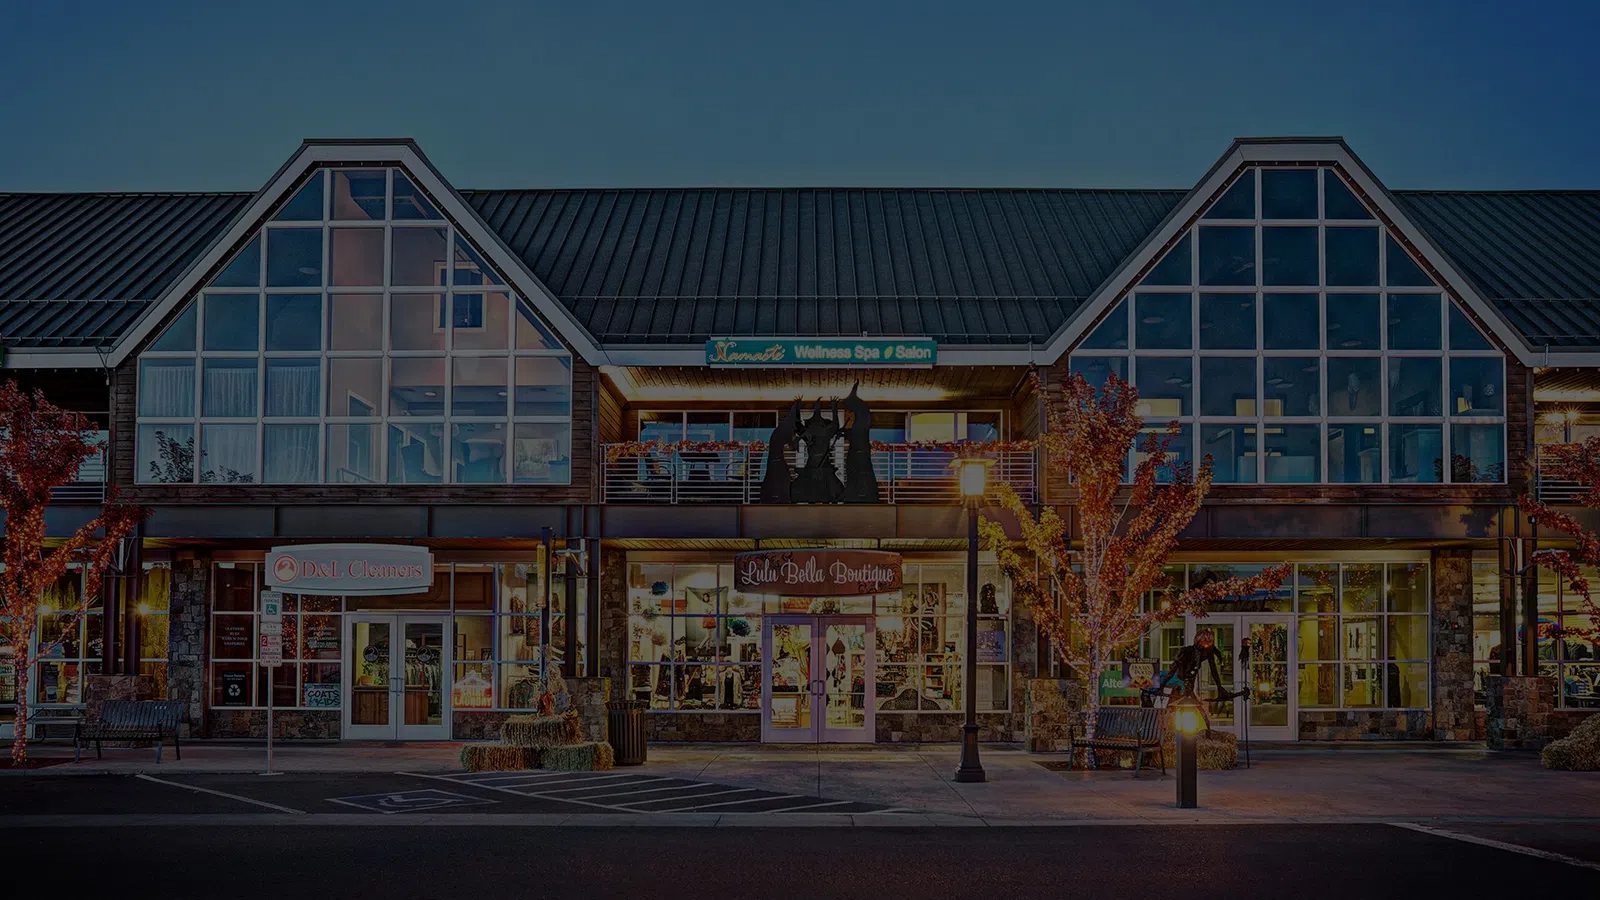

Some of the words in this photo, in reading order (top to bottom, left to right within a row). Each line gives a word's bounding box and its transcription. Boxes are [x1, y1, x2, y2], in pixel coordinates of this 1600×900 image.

[794, 345, 851, 359] Wellness
[854, 345, 880, 361] Spa
[895, 345, 931, 359] Salon
[302, 559, 344, 579] D&L
[348, 559, 424, 579] Cleaners
[741, 558, 779, 585] Lulu
[780, 556, 825, 585] Bella
[829, 558, 895, 590] Boutique
[262, 636, 268, 646] 2
[307, 690, 340, 698] COATS
[453, 696, 492, 706] LAUNDRY
